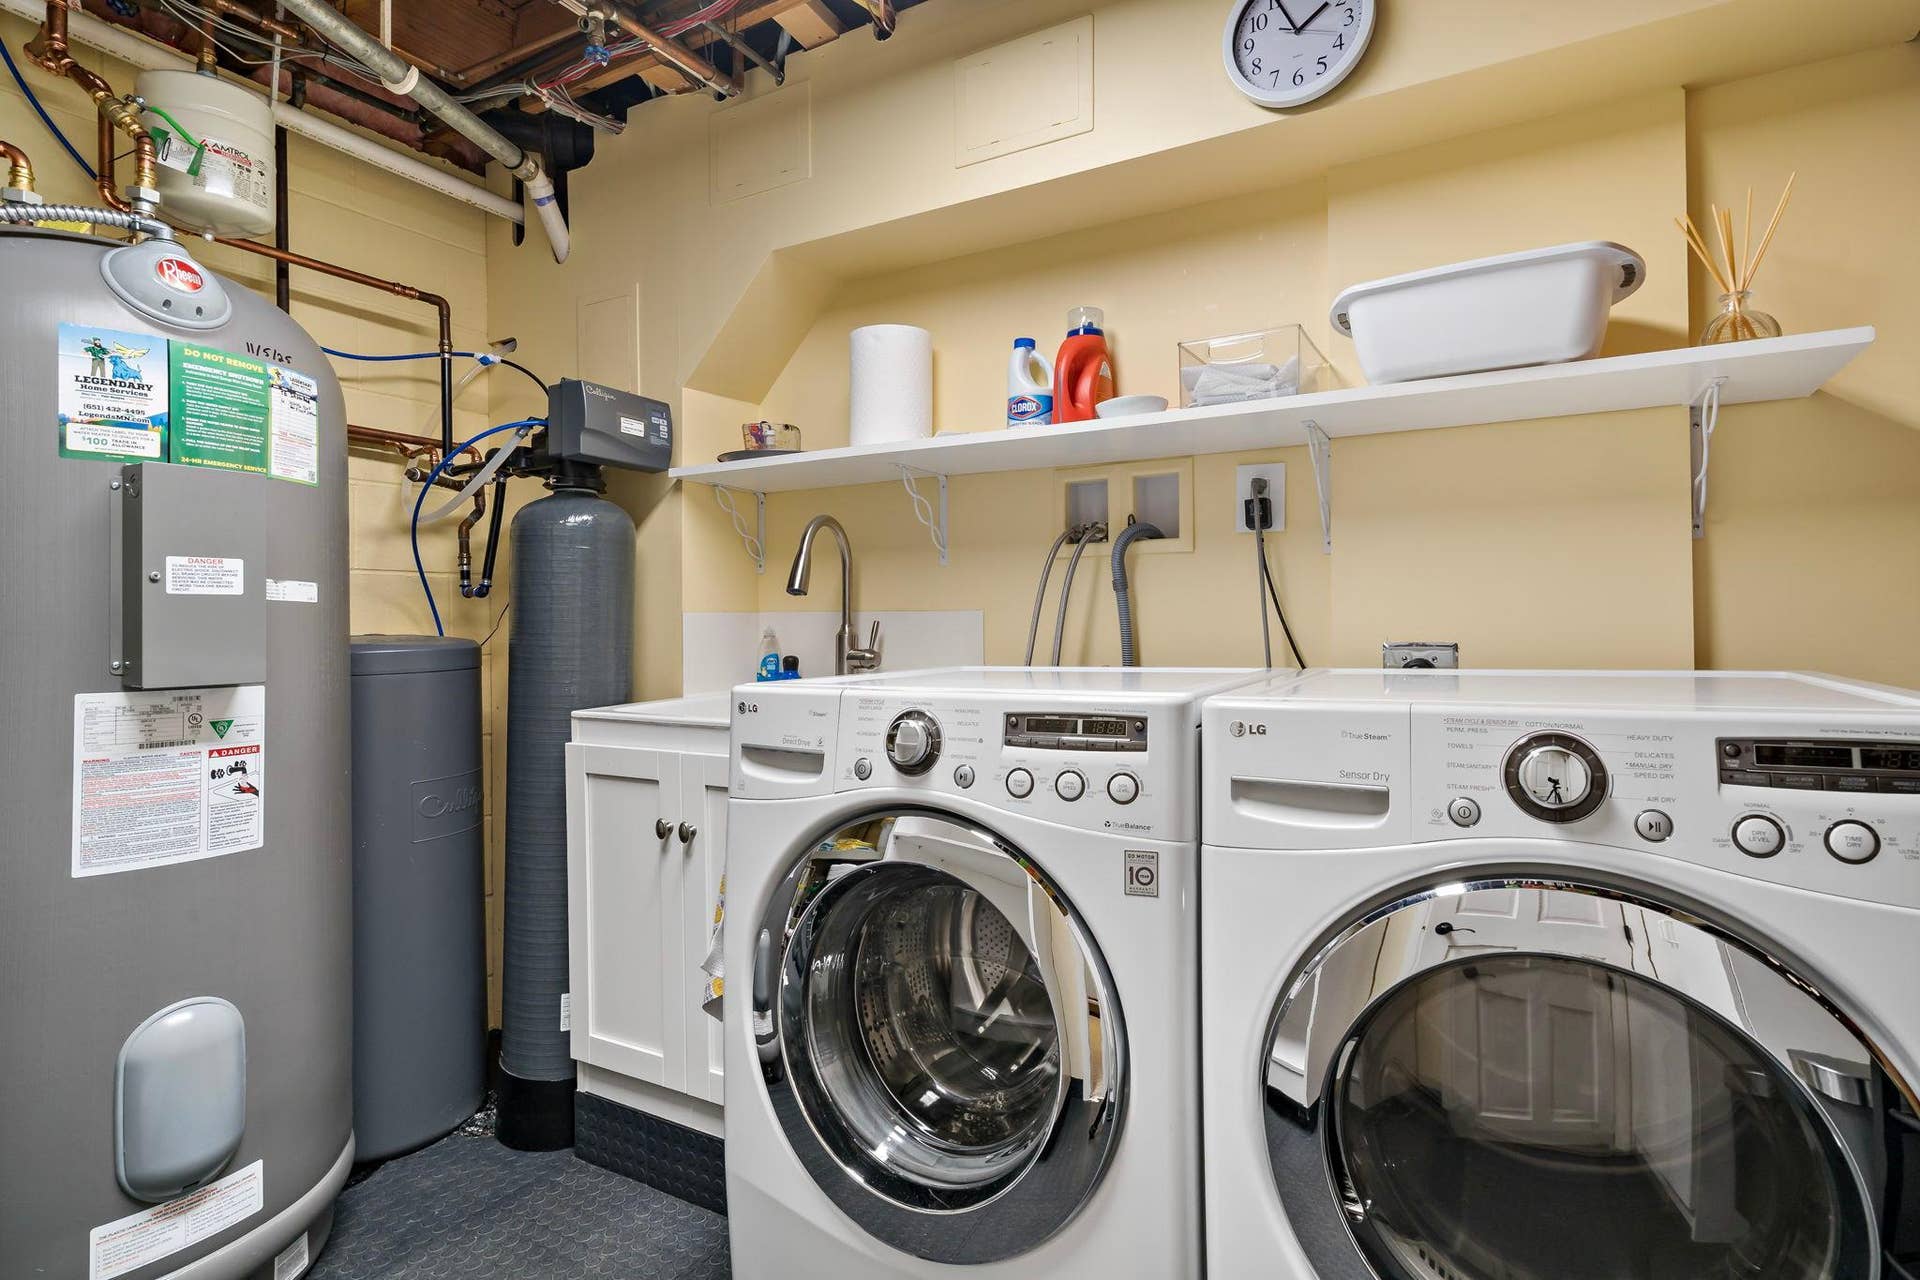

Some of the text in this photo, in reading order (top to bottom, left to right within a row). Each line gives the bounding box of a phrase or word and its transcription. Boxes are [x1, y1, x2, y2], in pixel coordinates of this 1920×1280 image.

[1250, 12, 1268, 34] 10
[1344, 8, 1354, 26] 3
[1244, 38, 1254, 57] 9
[1332, 33, 1344, 50] 4
[1252, 58, 1262, 76] 8
[1316, 55, 1328, 76] 5
[1269, 70, 1280, 88] 7
[1292, 67, 1304, 86] 6
[162, 260, 202, 286] Rheem
[183, 348, 264, 374] DO NOT REMOVE
[246, 342, 292, 364] 11/5/25
[74, 375, 154, 392] LEGENDARY
[80, 384, 108, 392] Home
[110, 387, 148, 398] Services
[586, 384, 616, 401] Culligan
[83, 403, 146, 416] (651) 432-4495
[1012, 402, 1037, 413] CLOROX
[78, 411, 150, 424] LegendsMN.com
[82, 436, 108, 446] $100
[181, 456, 202, 465] 24-HR
[203, 459, 244, 470] EMERGENCY
[748, 704, 758, 713] LG
[1248, 724, 1266, 735] LG
[221, 746, 258, 756] DANGER
[1339, 770, 1390, 782] Sensor Dry
[1112, 822, 1151, 831] TrueBalance
[1129, 866, 1154, 886] 10
